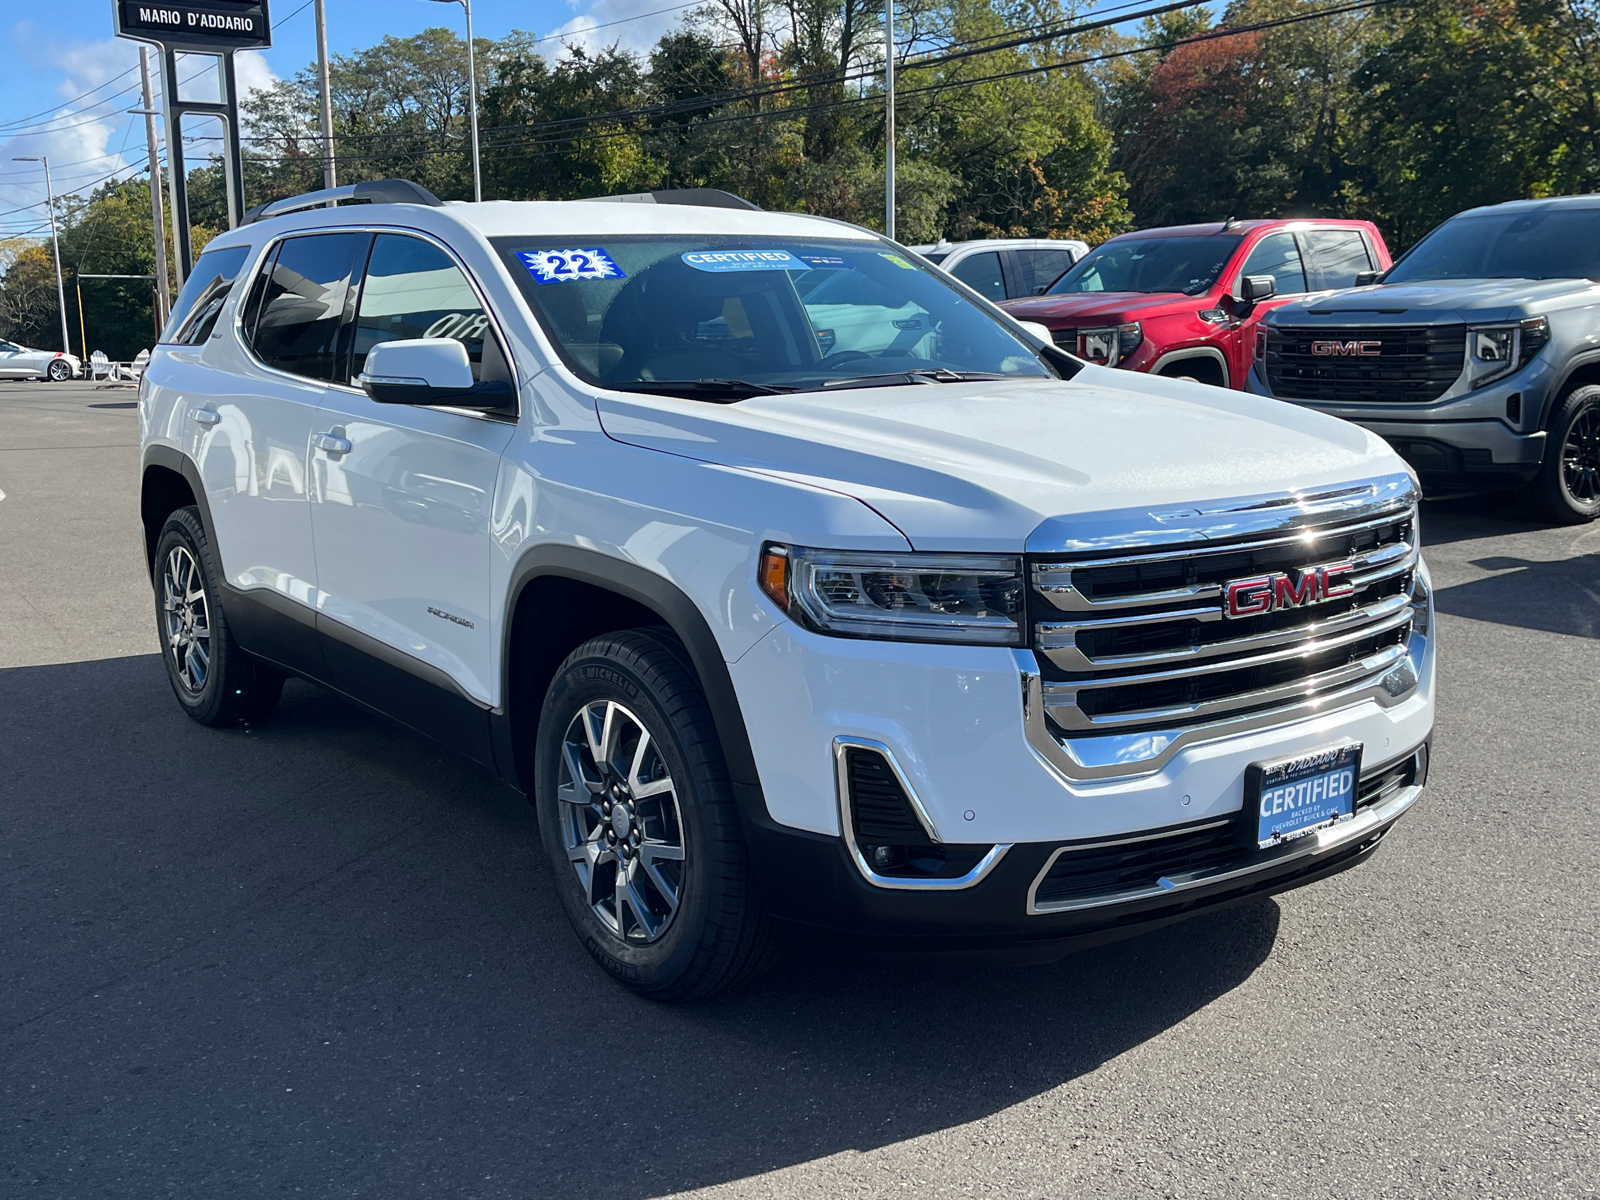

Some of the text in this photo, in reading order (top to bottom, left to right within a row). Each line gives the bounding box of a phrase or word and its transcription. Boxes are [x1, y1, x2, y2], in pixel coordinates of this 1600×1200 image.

[139, 8, 253, 31] MARIO D'ADDARIO
[546, 254, 597, 275] 22
[687, 252, 791, 263] CERTIFIED
[1311, 341, 1381, 356] GMC
[1224, 562, 1354, 620] GMC
[587, 667, 637, 698] MICHELIN
[1287, 749, 1339, 773] D'ADDARIO
[1260, 770, 1353, 818] CERTIFIED
[1271, 816, 1302, 832] CHEVROLET
[1303, 811, 1320, 823] BUICK
[1325, 805, 1339, 815] GMC
[1291, 804, 1321, 819] BACKED BY
[1259, 838, 1282, 850] NISSAN
[587, 940, 636, 979] MICHELIN
